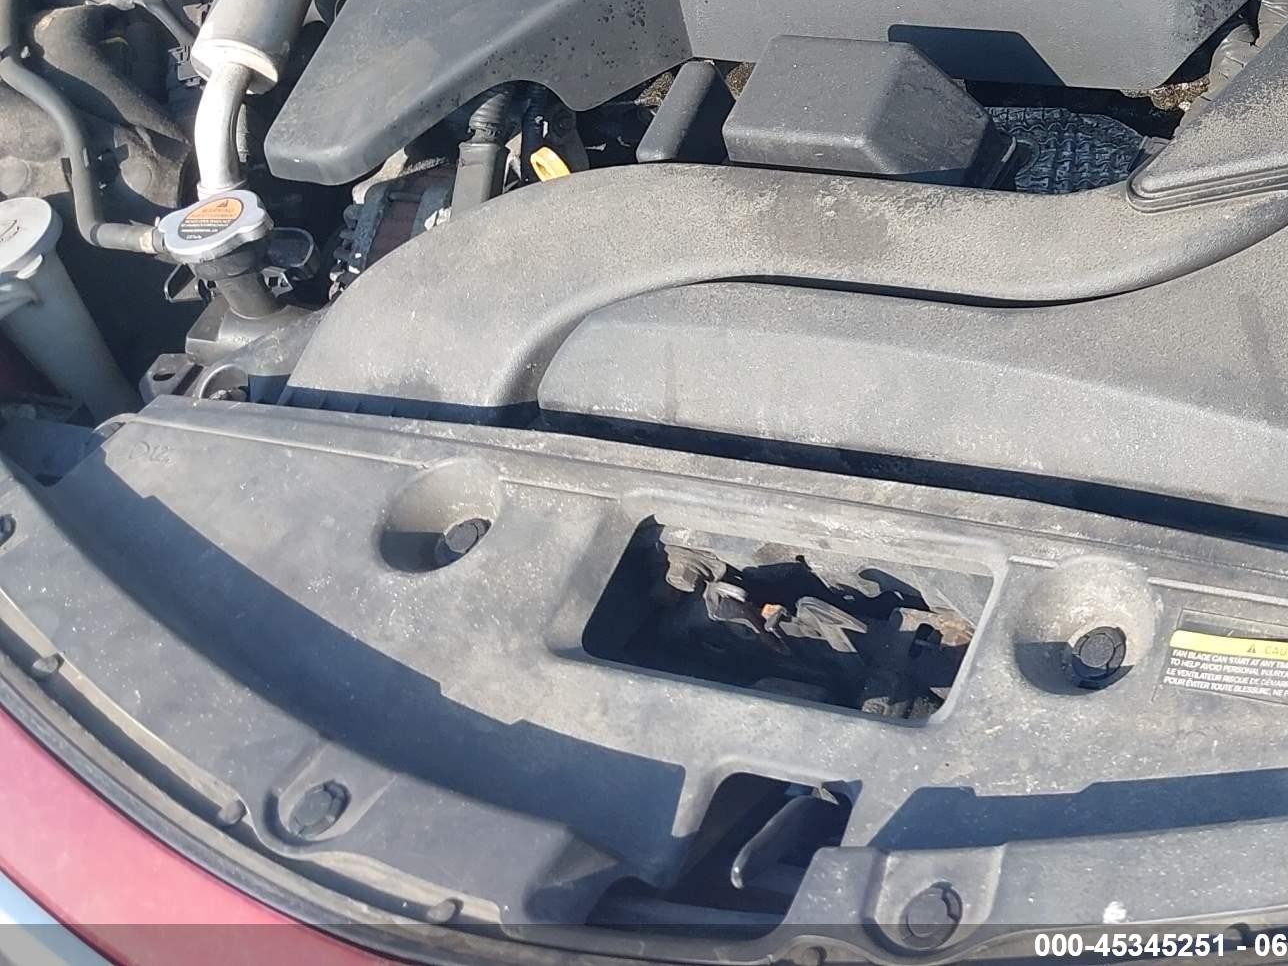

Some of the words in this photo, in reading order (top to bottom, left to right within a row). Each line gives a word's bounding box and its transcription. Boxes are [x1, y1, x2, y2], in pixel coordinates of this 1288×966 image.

[1171, 657, 1180, 665] TO
[1181, 659, 1200, 669] HELP
[1200, 662, 1222, 672] AVOID
[1223, 664, 1258, 676] PERSONAL
[1172, 649, 1187, 657] FAN
[1188, 651, 1211, 661] BLADE
[1212, 654, 1229, 663] CAN
[1229, 656, 1249, 665] START
[1250, 658, 1260, 666] AT
[1260, 659, 1275, 668] ANY
[1164, 676, 1186, 685] POUR
[1211, 683, 1233, 691] TOUTE
[1166, 668, 1177, 676] LE
[1178, 669, 1222, 681] VENTILATEUR
[1222, 674, 1249, 684] RISQUE
[1250, 676, 1259, 684] DE
